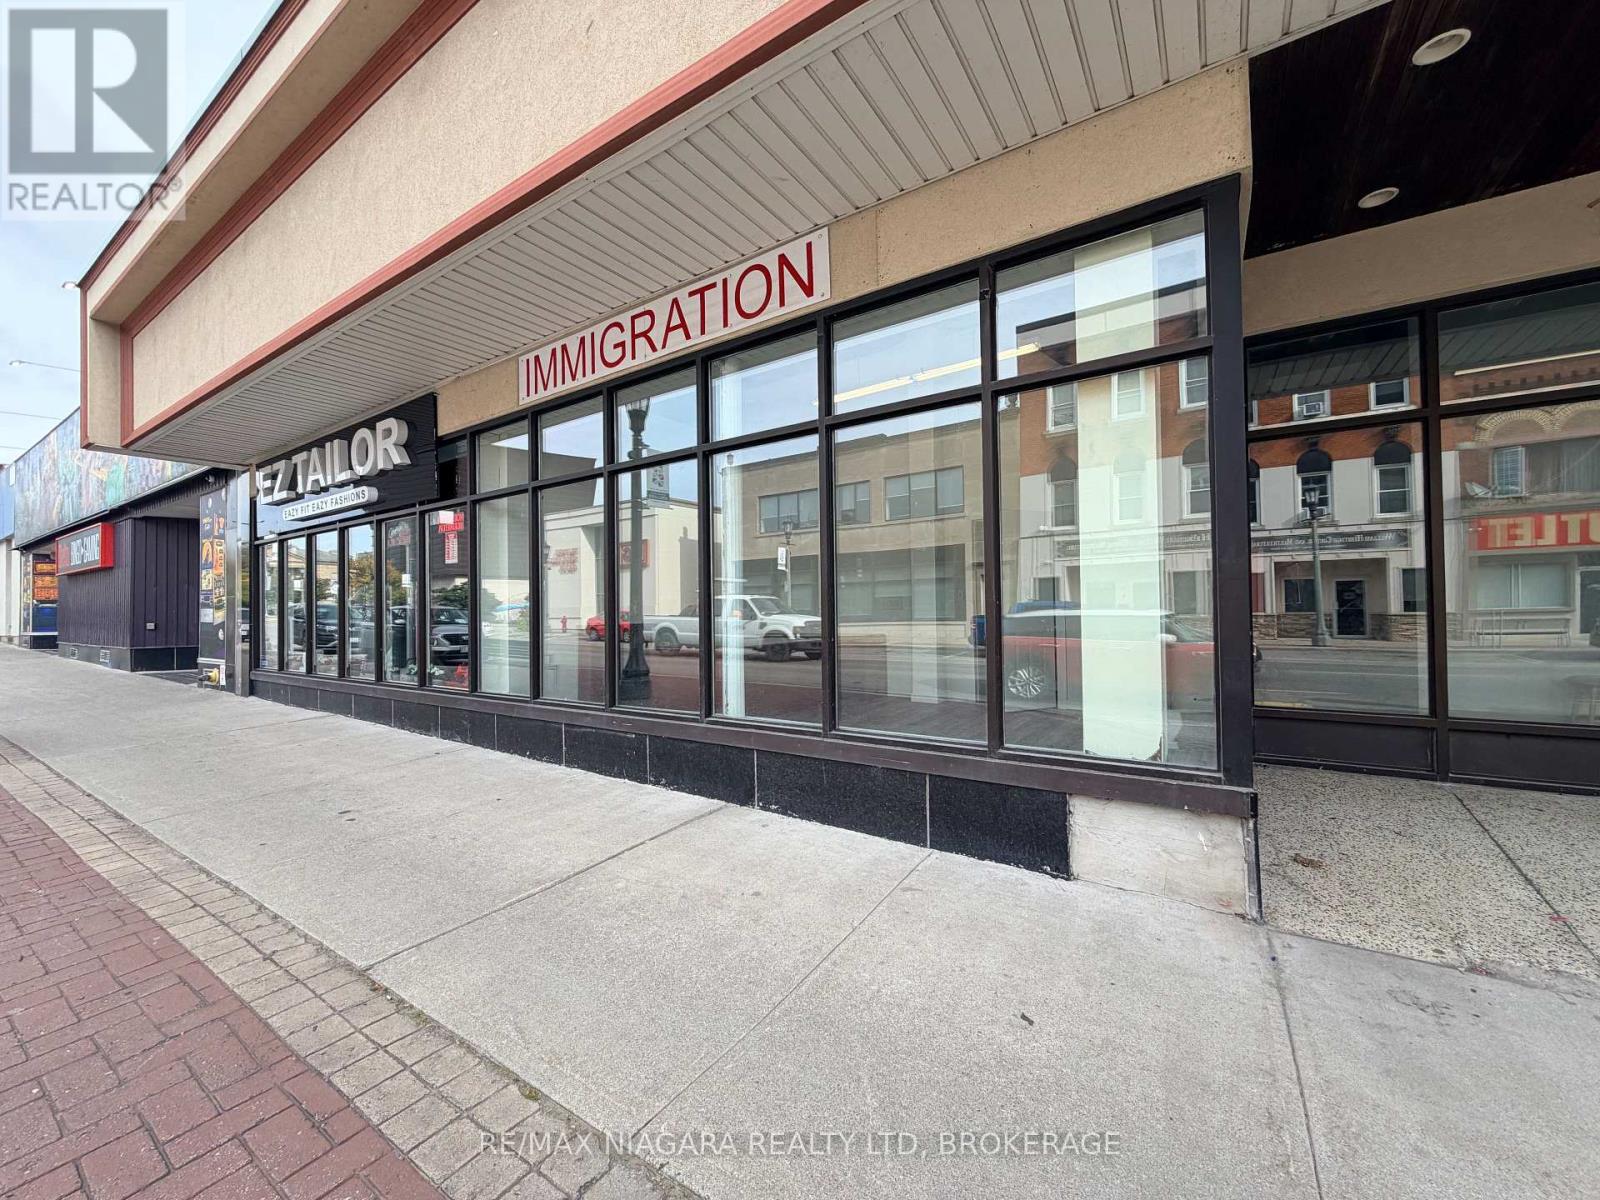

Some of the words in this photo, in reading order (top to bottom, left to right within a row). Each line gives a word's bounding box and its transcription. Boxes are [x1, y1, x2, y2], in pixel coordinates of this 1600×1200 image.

[524, 240, 814, 398] IMMIGRATION
[284, 508, 299, 519] EAZY
[300, 504, 310, 515] FIT
[311, 499, 328, 512] EAZY
[330, 489, 366, 507] FASHIONS
